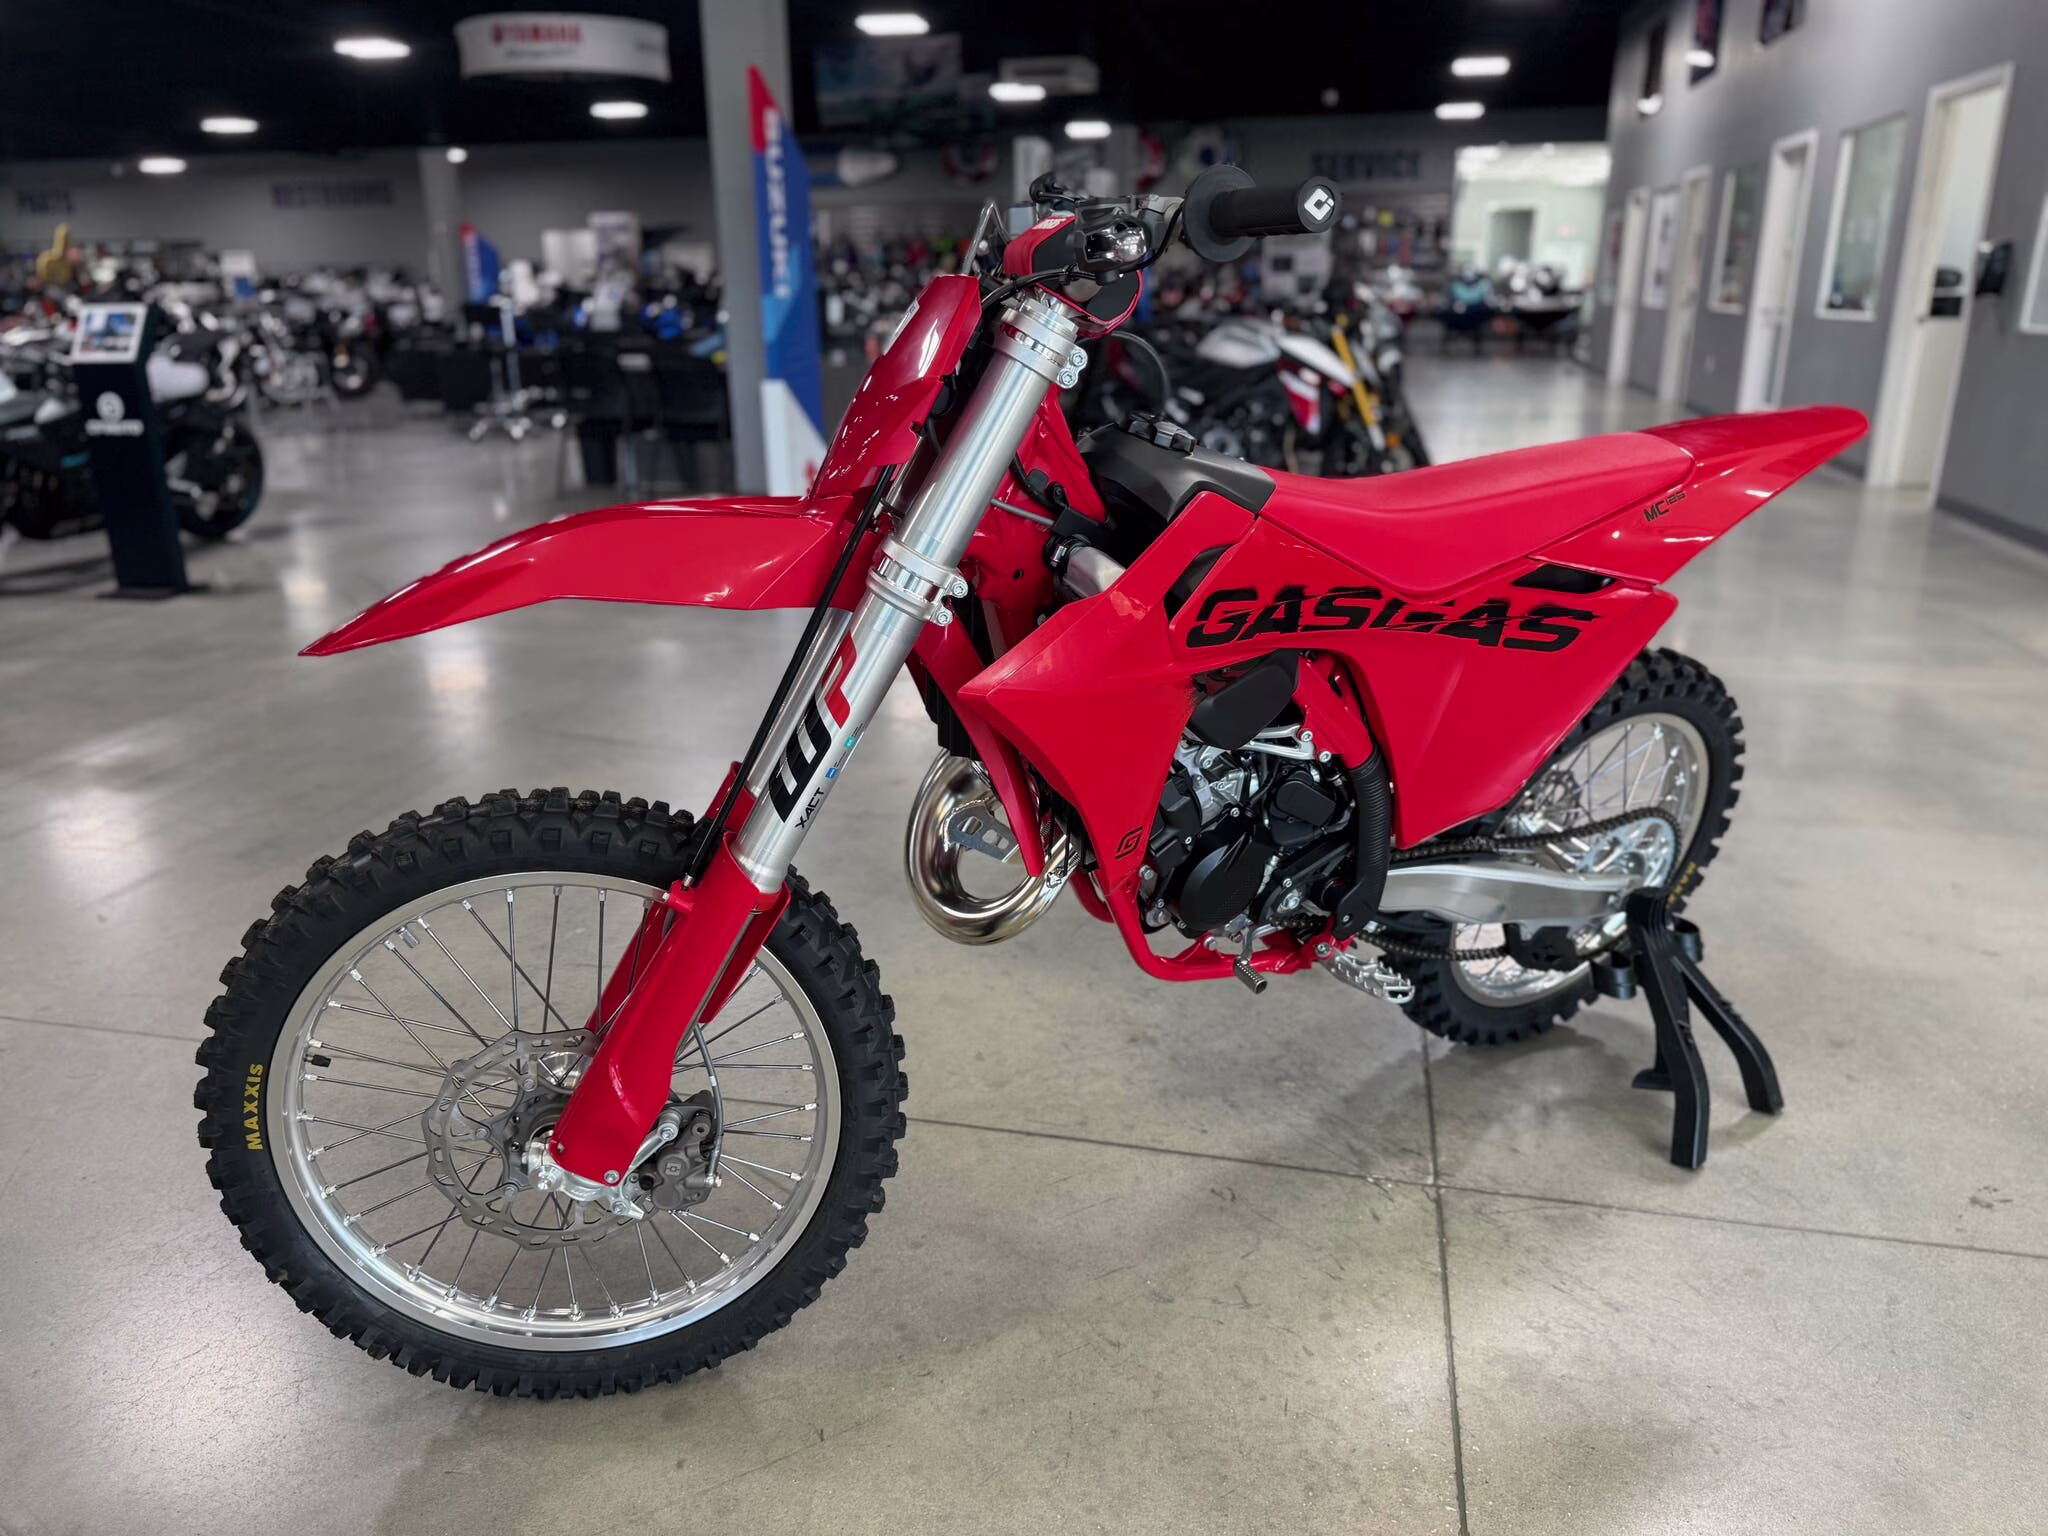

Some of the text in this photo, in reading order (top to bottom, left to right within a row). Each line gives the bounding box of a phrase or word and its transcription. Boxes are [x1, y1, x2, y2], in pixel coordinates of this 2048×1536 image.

[763, 108, 791, 299] SUZUKI
[1186, 584, 1600, 652] GASGAS
[795, 786, 825, 828] XACT
[243, 1063, 264, 1150] MAXXIS
